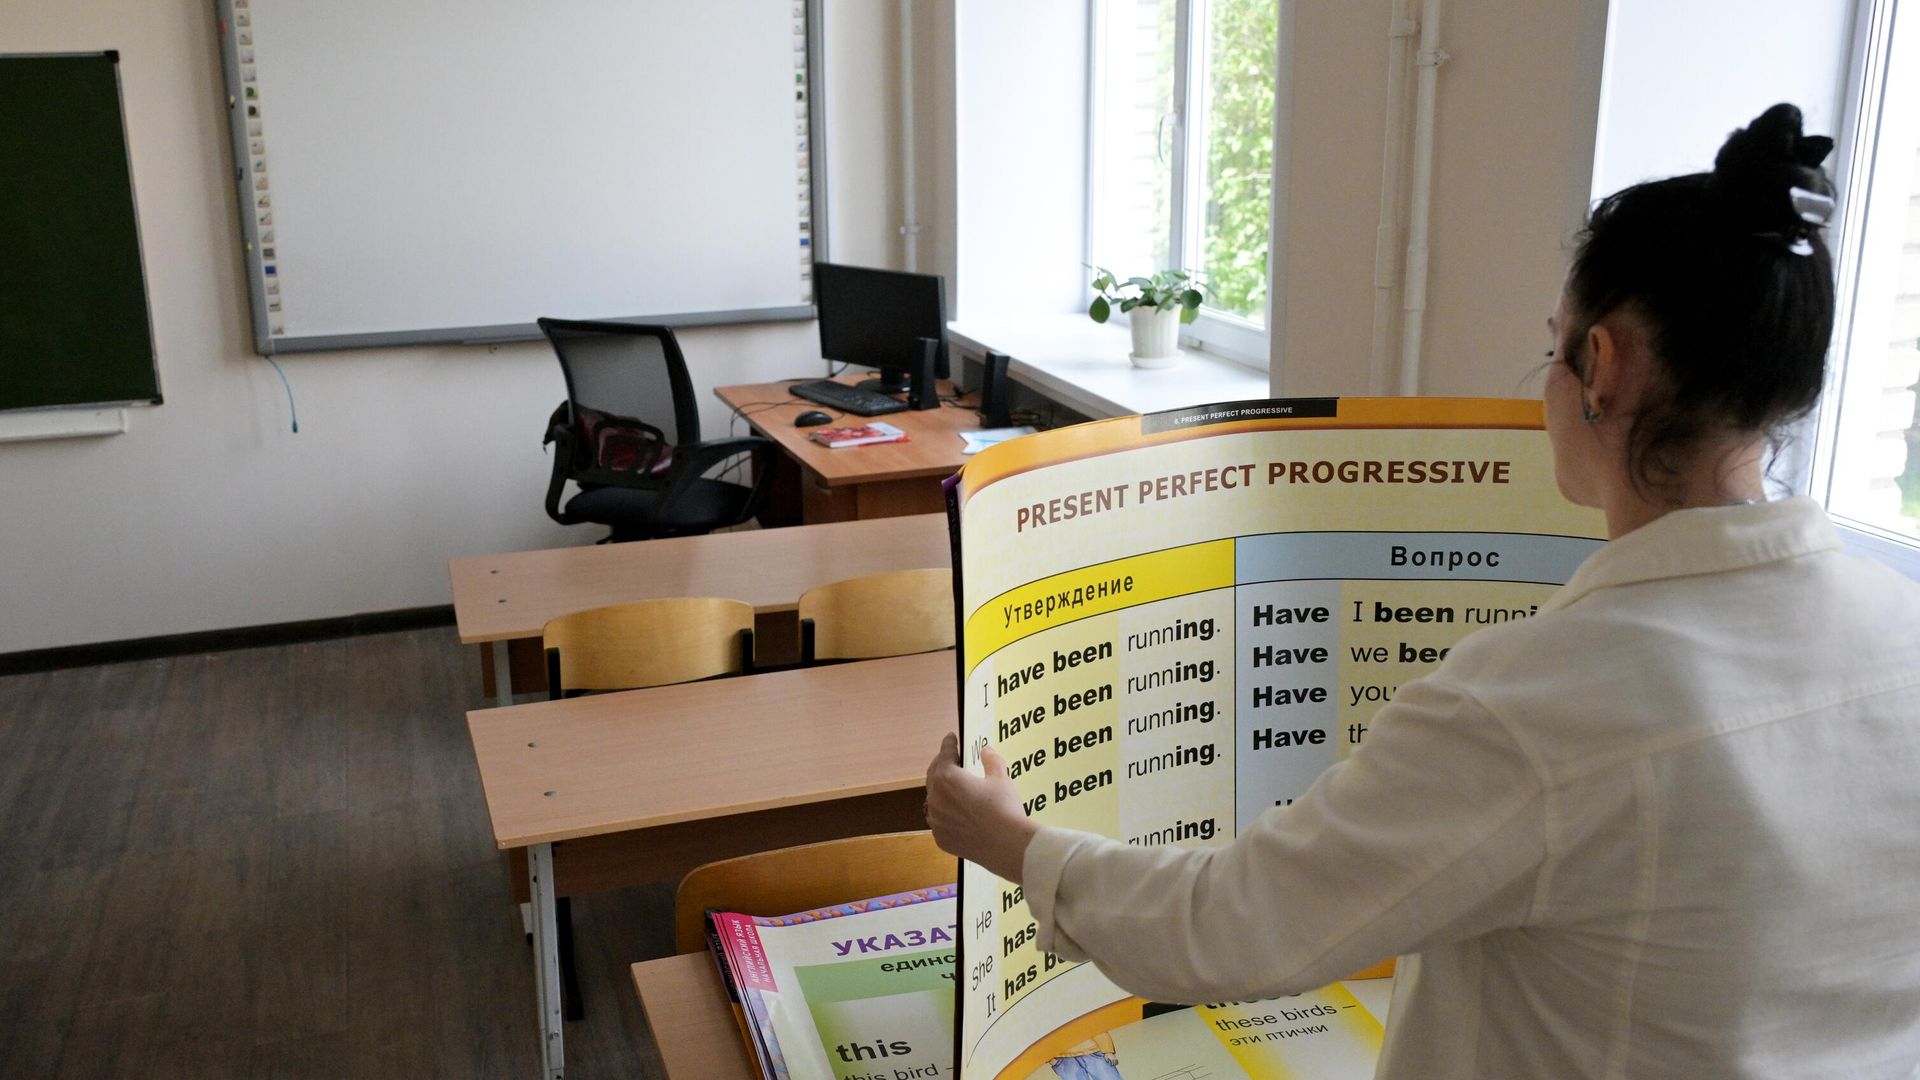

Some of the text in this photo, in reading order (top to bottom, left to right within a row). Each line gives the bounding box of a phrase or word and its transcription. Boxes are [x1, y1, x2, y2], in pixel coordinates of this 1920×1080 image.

[1181, 413, 1209, 424] PRESENT
[1210, 409, 1239, 420] PERFECT
[1240, 406, 1293, 416] PROGRESSIVE
[1017, 461, 1511, 533] PRESENT PERFECT PROGRESSIVE
[1390, 545, 1500, 571] Вопрос
[1004, 575, 1134, 629] Утверждение
[1253, 604, 1330, 627] Have
[1352, 601, 1363, 622] I
[1374, 601, 1454, 623] been
[983, 618, 1221, 708] I have been running.
[1253, 645, 1329, 668] Have
[1350, 647, 1389, 663] we
[1253, 685, 1397, 708] Have you
[971, 660, 1221, 766] We have been running.
[1007, 701, 1221, 780] ave been running.
[1253, 727, 1327, 750] Have
[1054, 769, 1113, 803] been
[1128, 743, 1221, 778] running.
[976, 910, 992, 940] He
[731, 919, 760, 984] АНГЛИЙСКИЙ ЯЗЫК
[972, 922, 1037, 991] She has
[987, 992, 996, 1018] It
[1004, 964, 1038, 1001] has
[1215, 1011, 1278, 1032] these
[1281, 1003, 1337, 1022] birds
[1229, 1024, 1329, 1047] эти птички
[836, 1039, 912, 1063] this
[894, 1063, 939, 1080] bird
